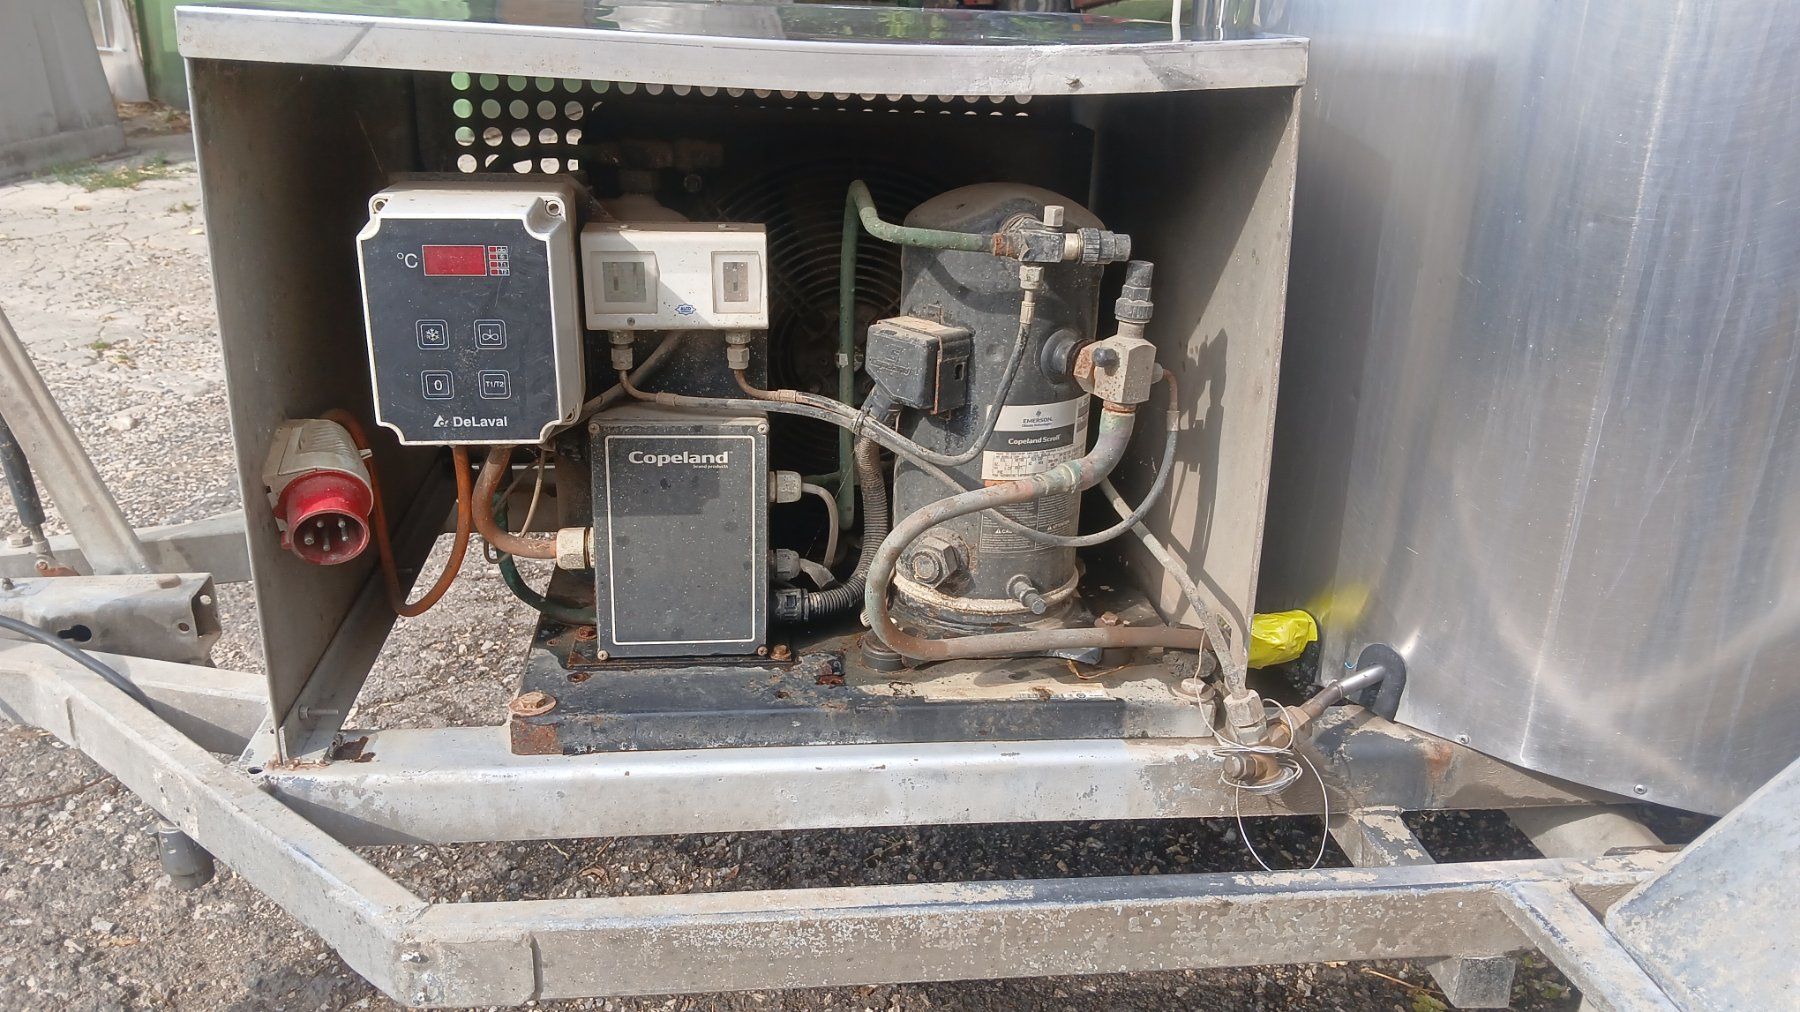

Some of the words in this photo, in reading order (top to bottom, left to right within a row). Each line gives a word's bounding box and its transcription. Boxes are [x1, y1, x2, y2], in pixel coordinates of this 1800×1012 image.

[397, 252, 418, 268] °C
[453, 417, 508, 427] DeLaval
[1008, 437, 1042, 445] Copeland
[628, 451, 728, 467] Copeland
